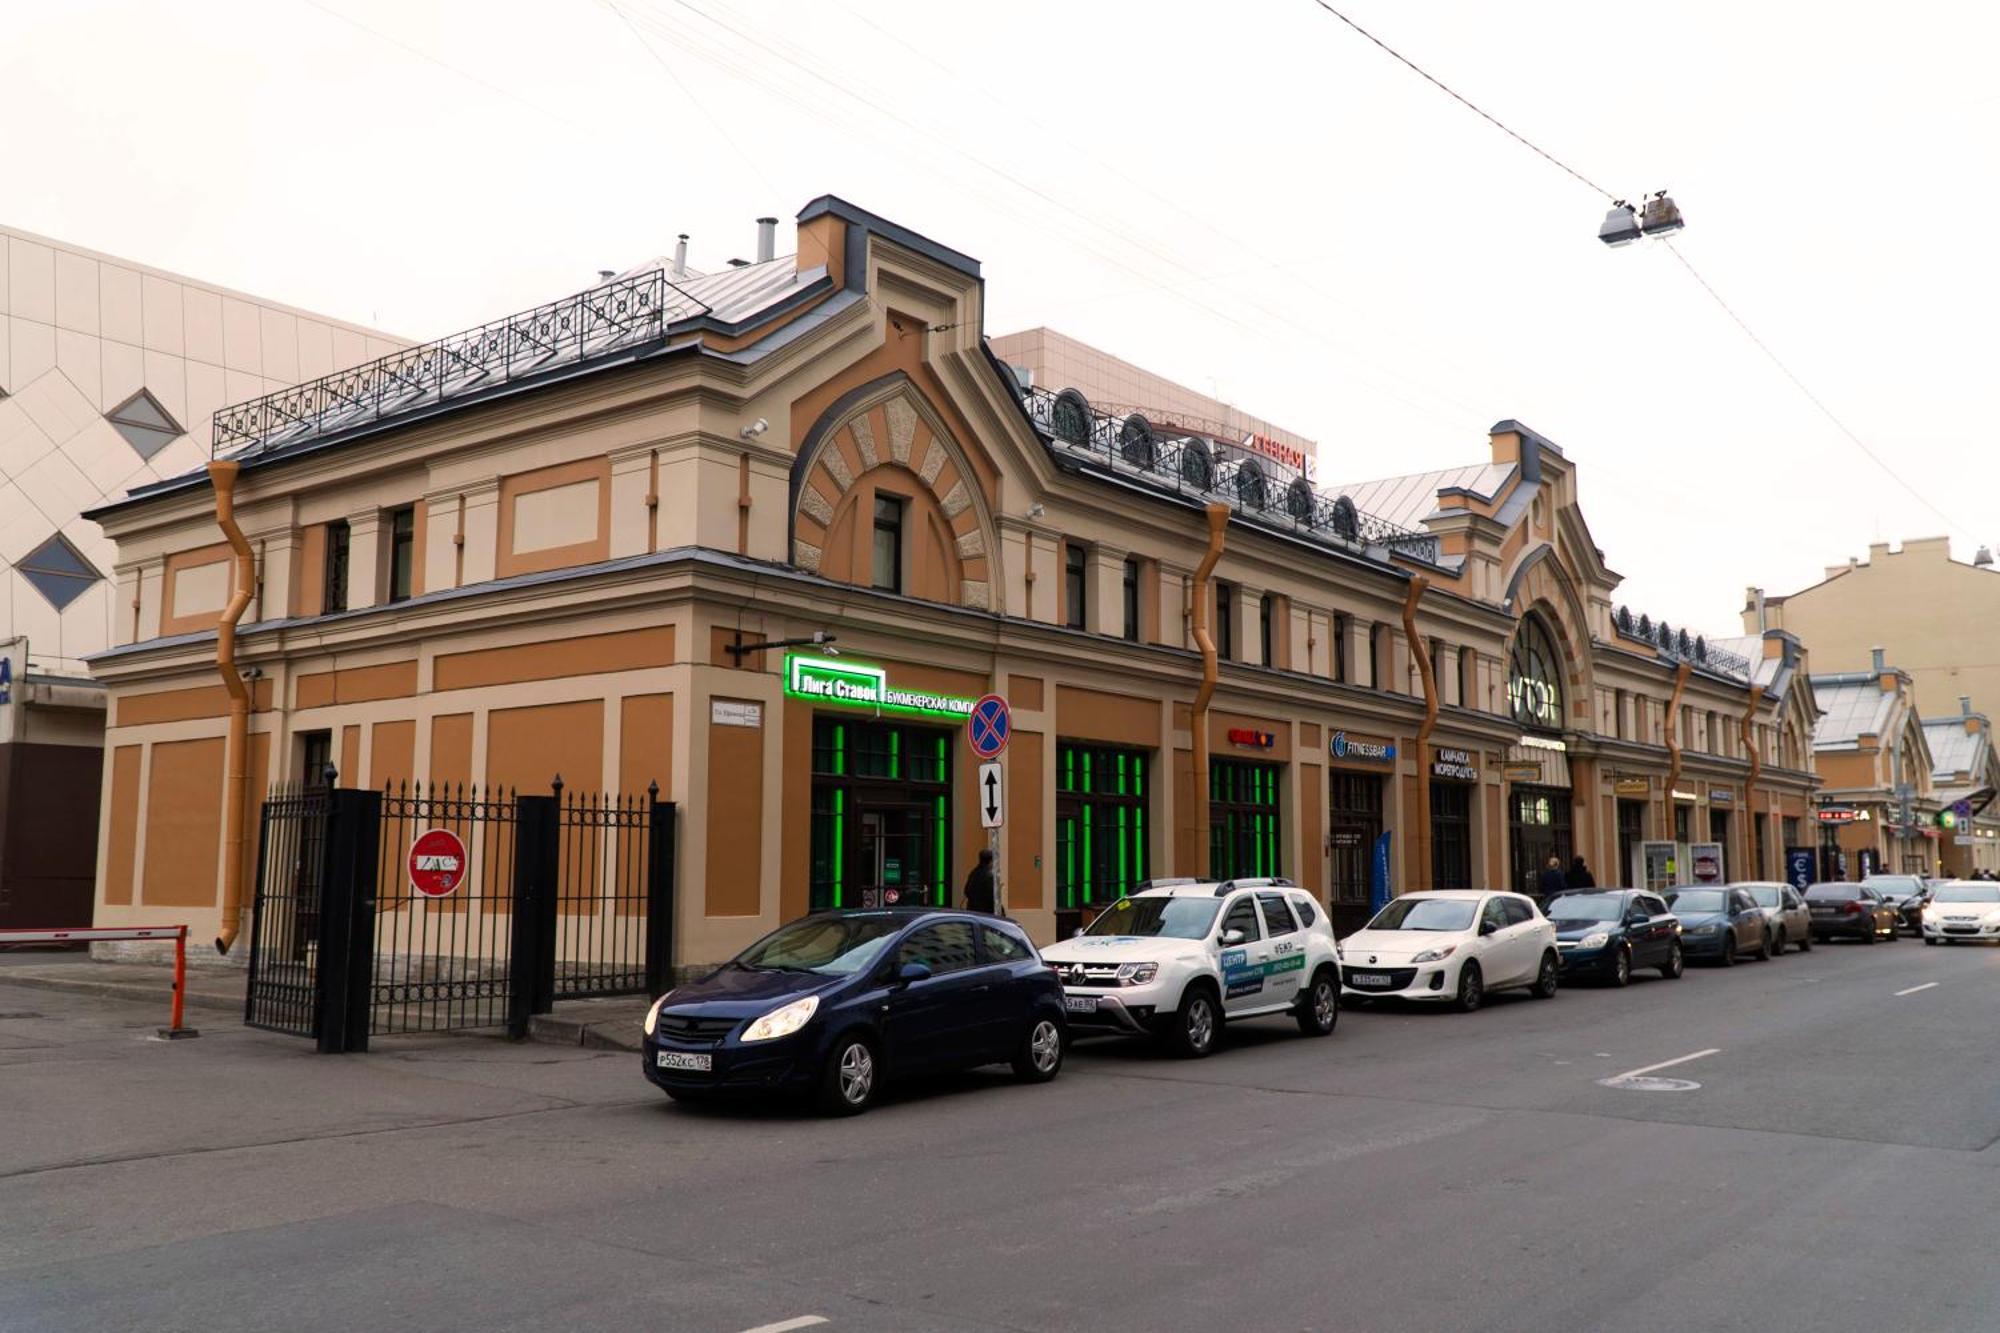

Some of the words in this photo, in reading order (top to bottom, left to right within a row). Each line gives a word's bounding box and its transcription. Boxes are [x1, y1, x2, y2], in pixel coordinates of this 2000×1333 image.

[802, 674, 833, 696] Лига
[836, 679, 877, 701] Ставок
[887, 691, 948, 710] БУКМЕКЕРСКАЯ
